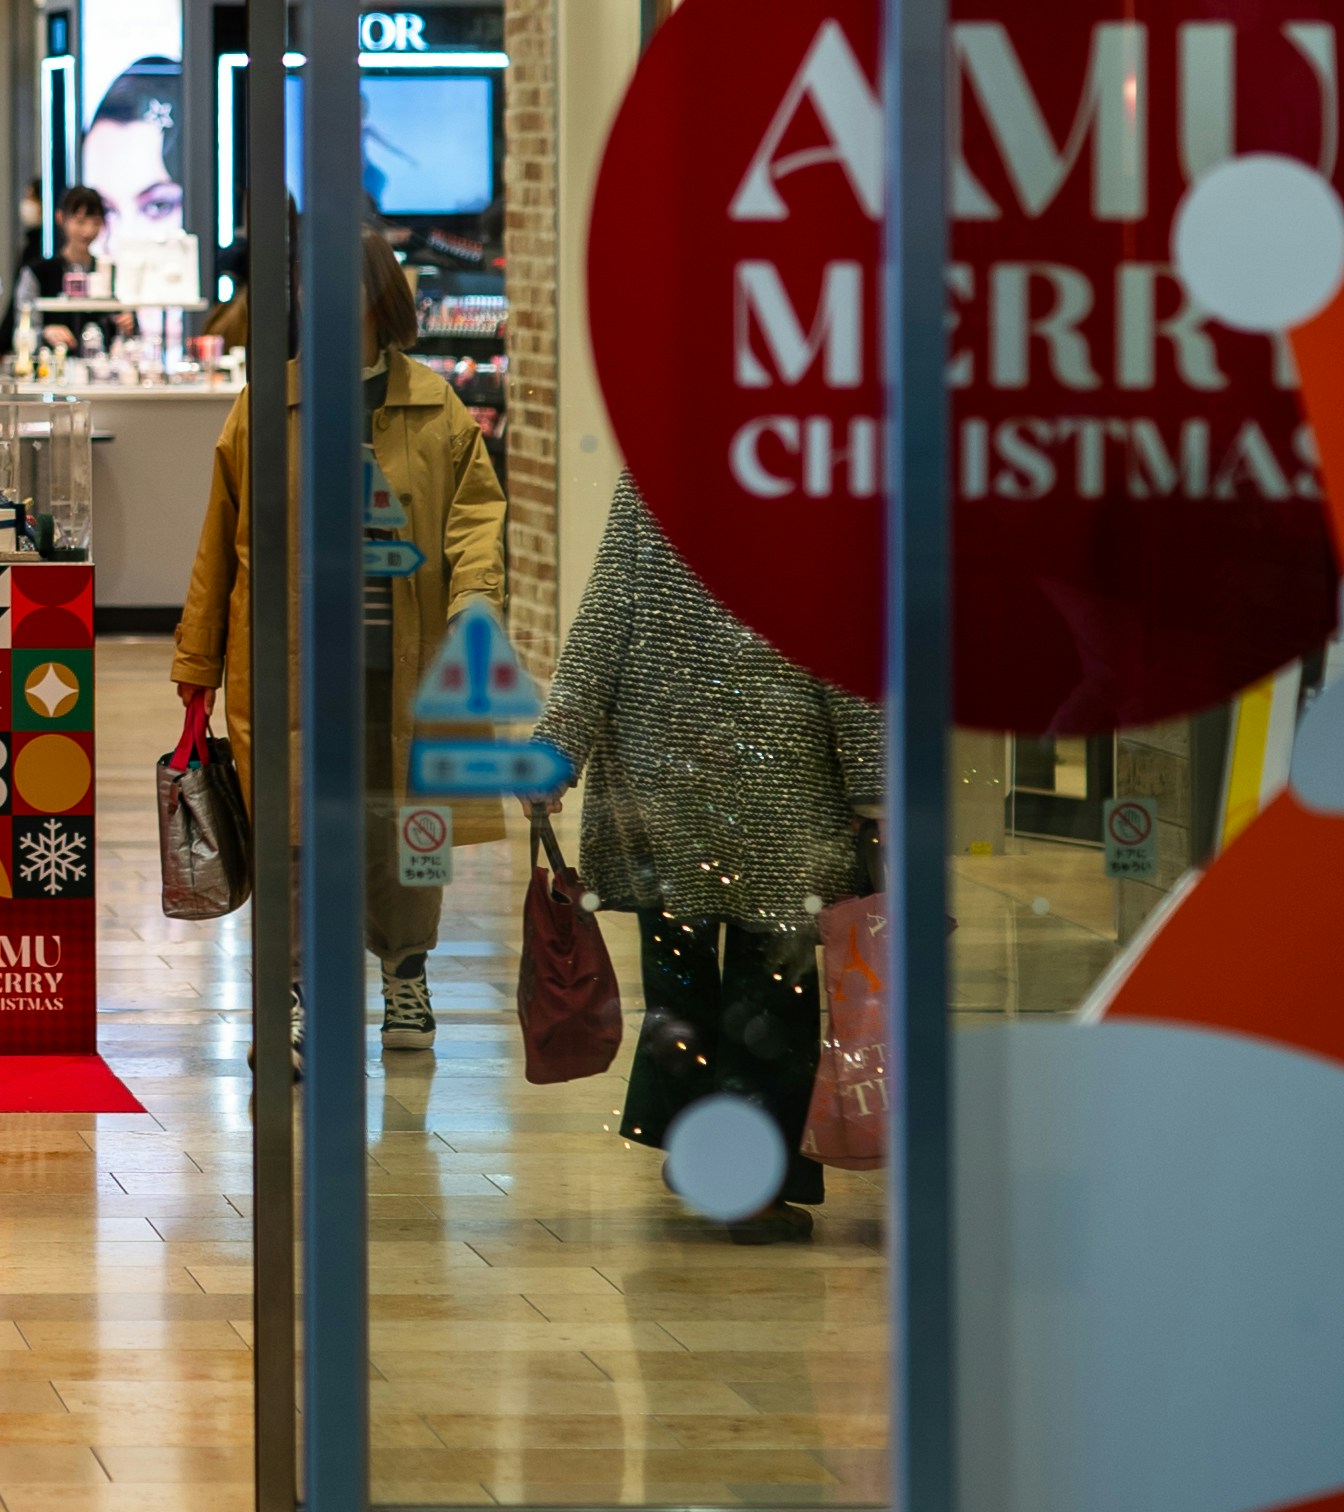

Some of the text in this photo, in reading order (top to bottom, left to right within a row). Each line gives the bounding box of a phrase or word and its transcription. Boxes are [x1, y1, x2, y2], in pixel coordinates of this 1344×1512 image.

[358, 11, 431, 51] OR
[727, 17, 1342, 223] AMU
[734, 261, 1302, 391] MRR
[407, 855, 443, 866] ドアに
